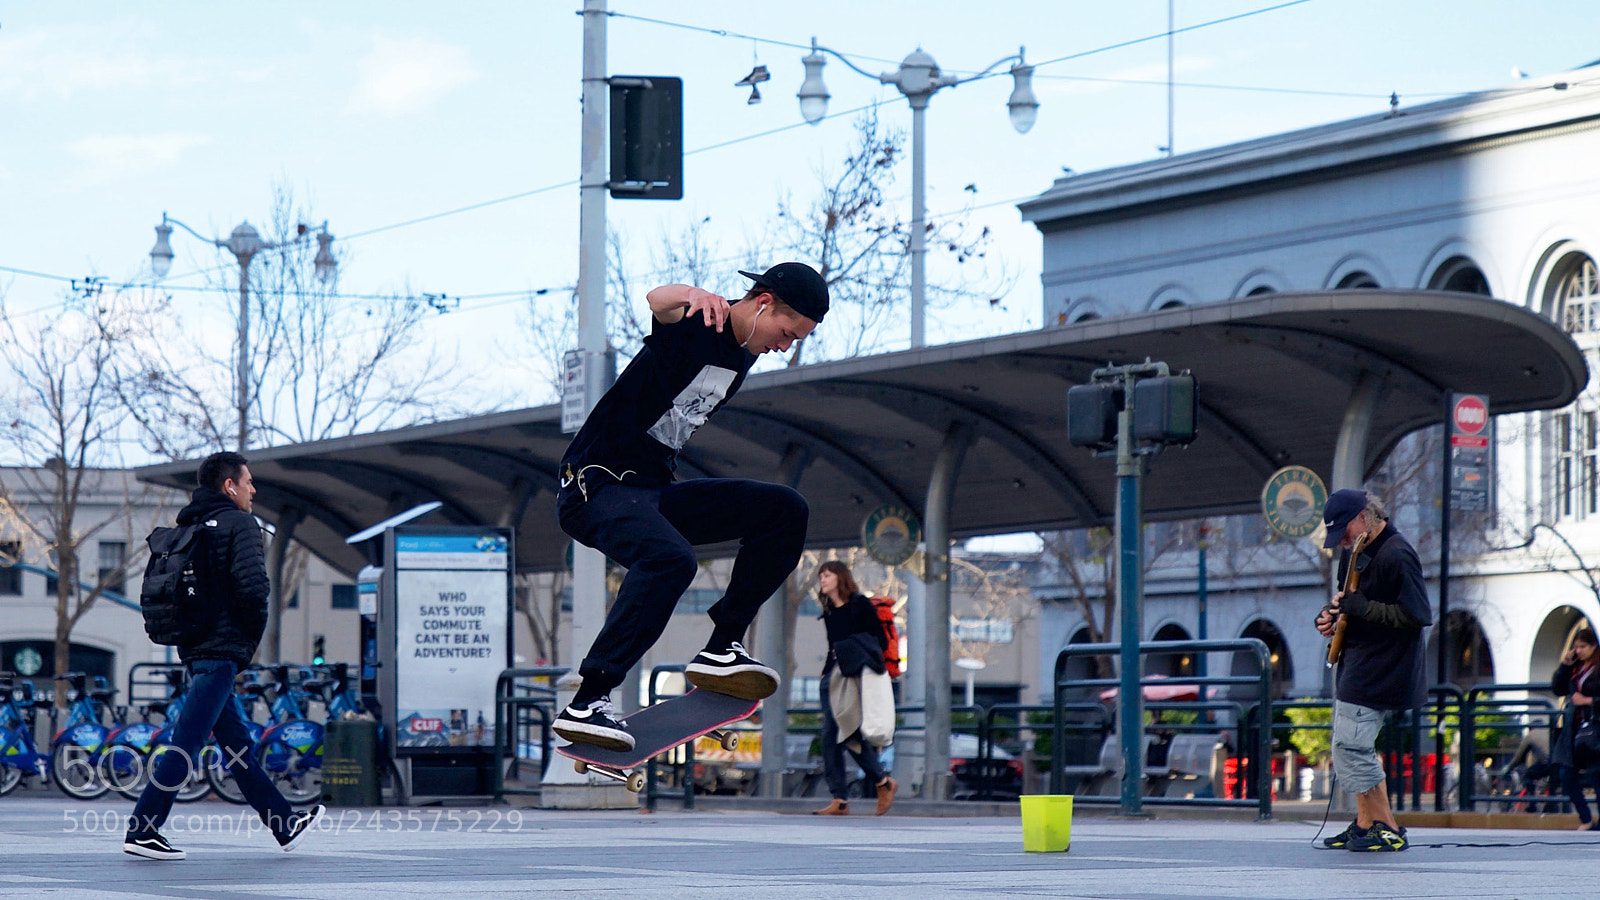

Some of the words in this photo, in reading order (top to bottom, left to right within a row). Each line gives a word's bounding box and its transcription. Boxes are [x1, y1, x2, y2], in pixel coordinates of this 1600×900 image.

[1274, 470, 1319, 488] FERRY
[1268, 508, 1323, 536] TERMINAL
[438, 592, 467, 603] WHO
[419, 606, 450, 617] SAYS
[453, 606, 486, 617] YOUR
[423, 620, 482, 631] COMMUTE
[415, 634, 451, 645] CAN'T
[454, 634, 470, 645] BE
[472, 634, 490, 645] AN
[414, 648, 492, 659] ADVENTURE?
[412, 719, 440, 731] CLIF
[72, 727, 101, 741] Ford
[125, 727, 154, 742] Ford
[281, 725, 313, 741] Ford
